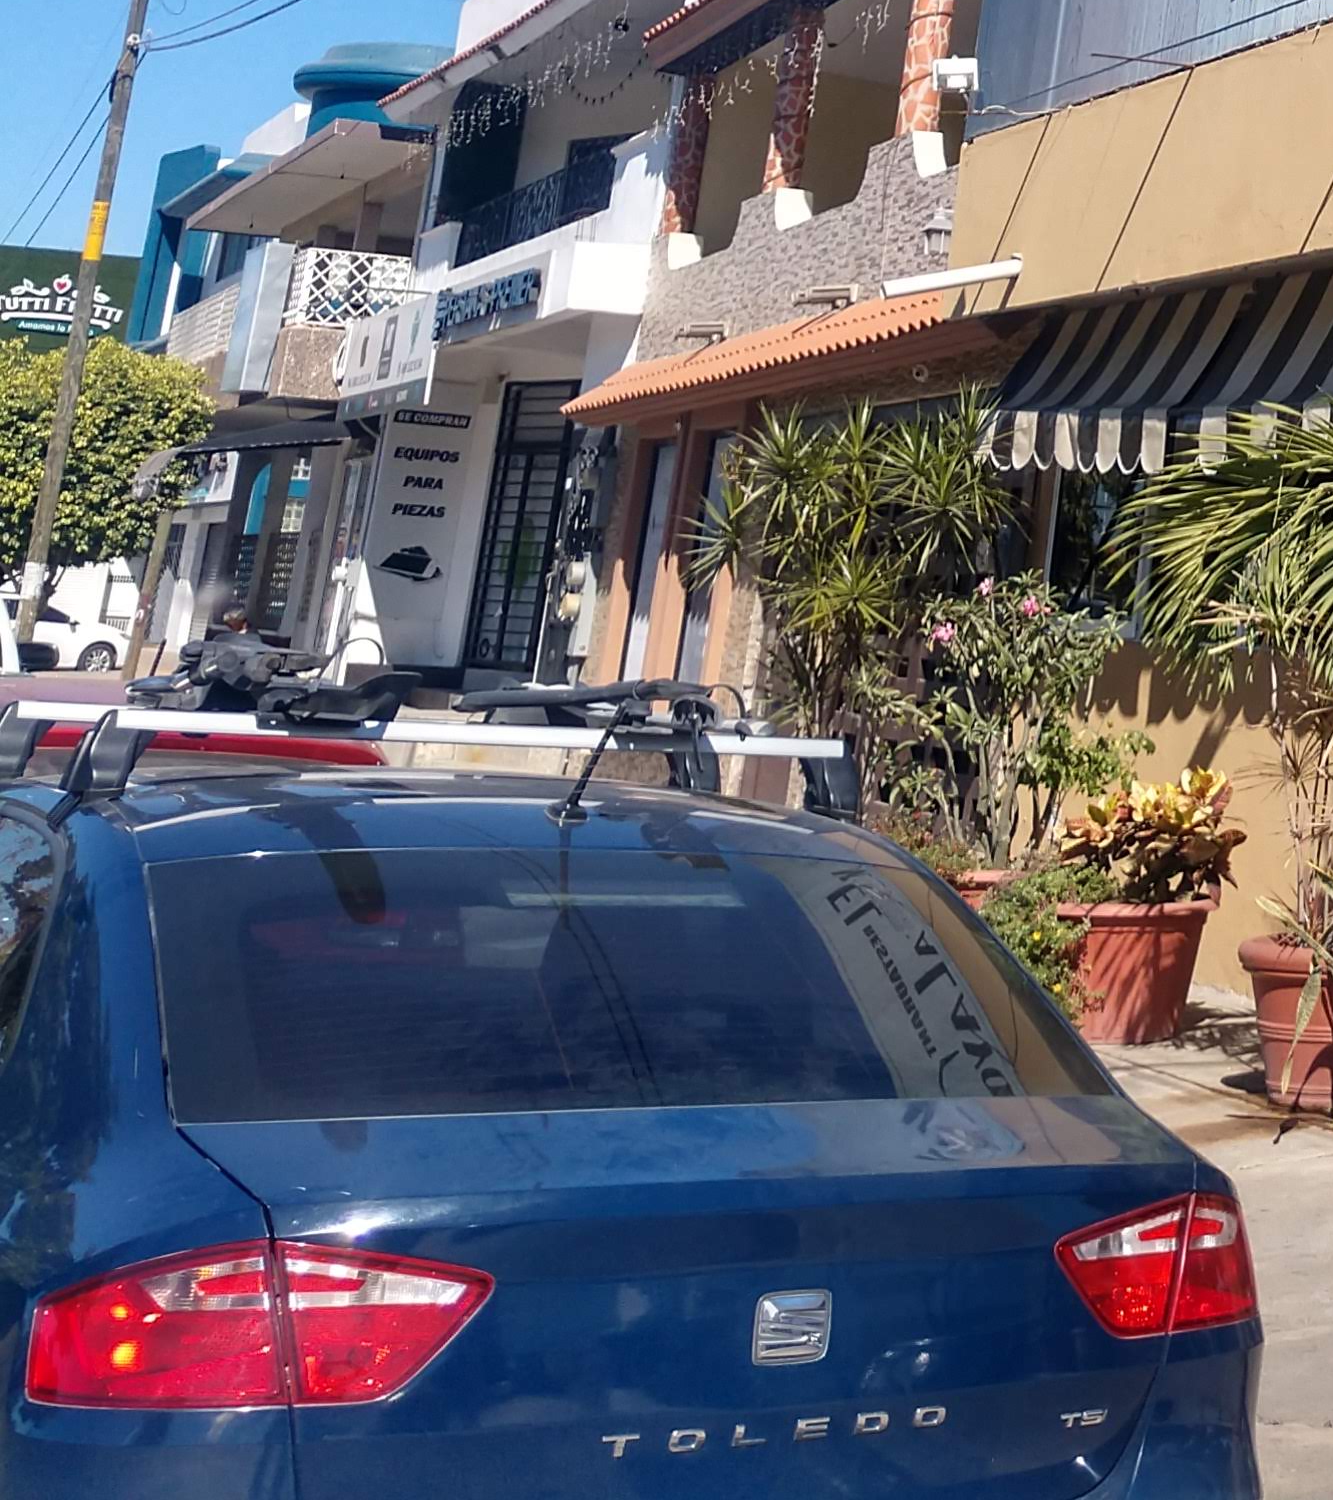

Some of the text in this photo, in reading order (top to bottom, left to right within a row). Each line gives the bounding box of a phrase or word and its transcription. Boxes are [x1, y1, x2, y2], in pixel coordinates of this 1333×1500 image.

[55, 295, 124, 323] FTTI
[393, 446, 461, 463] EQUIPOS
[402, 475, 444, 490] PARA
[391, 502, 447, 518] PIEZAS
[601, 1404, 947, 1459] TOLEDO
